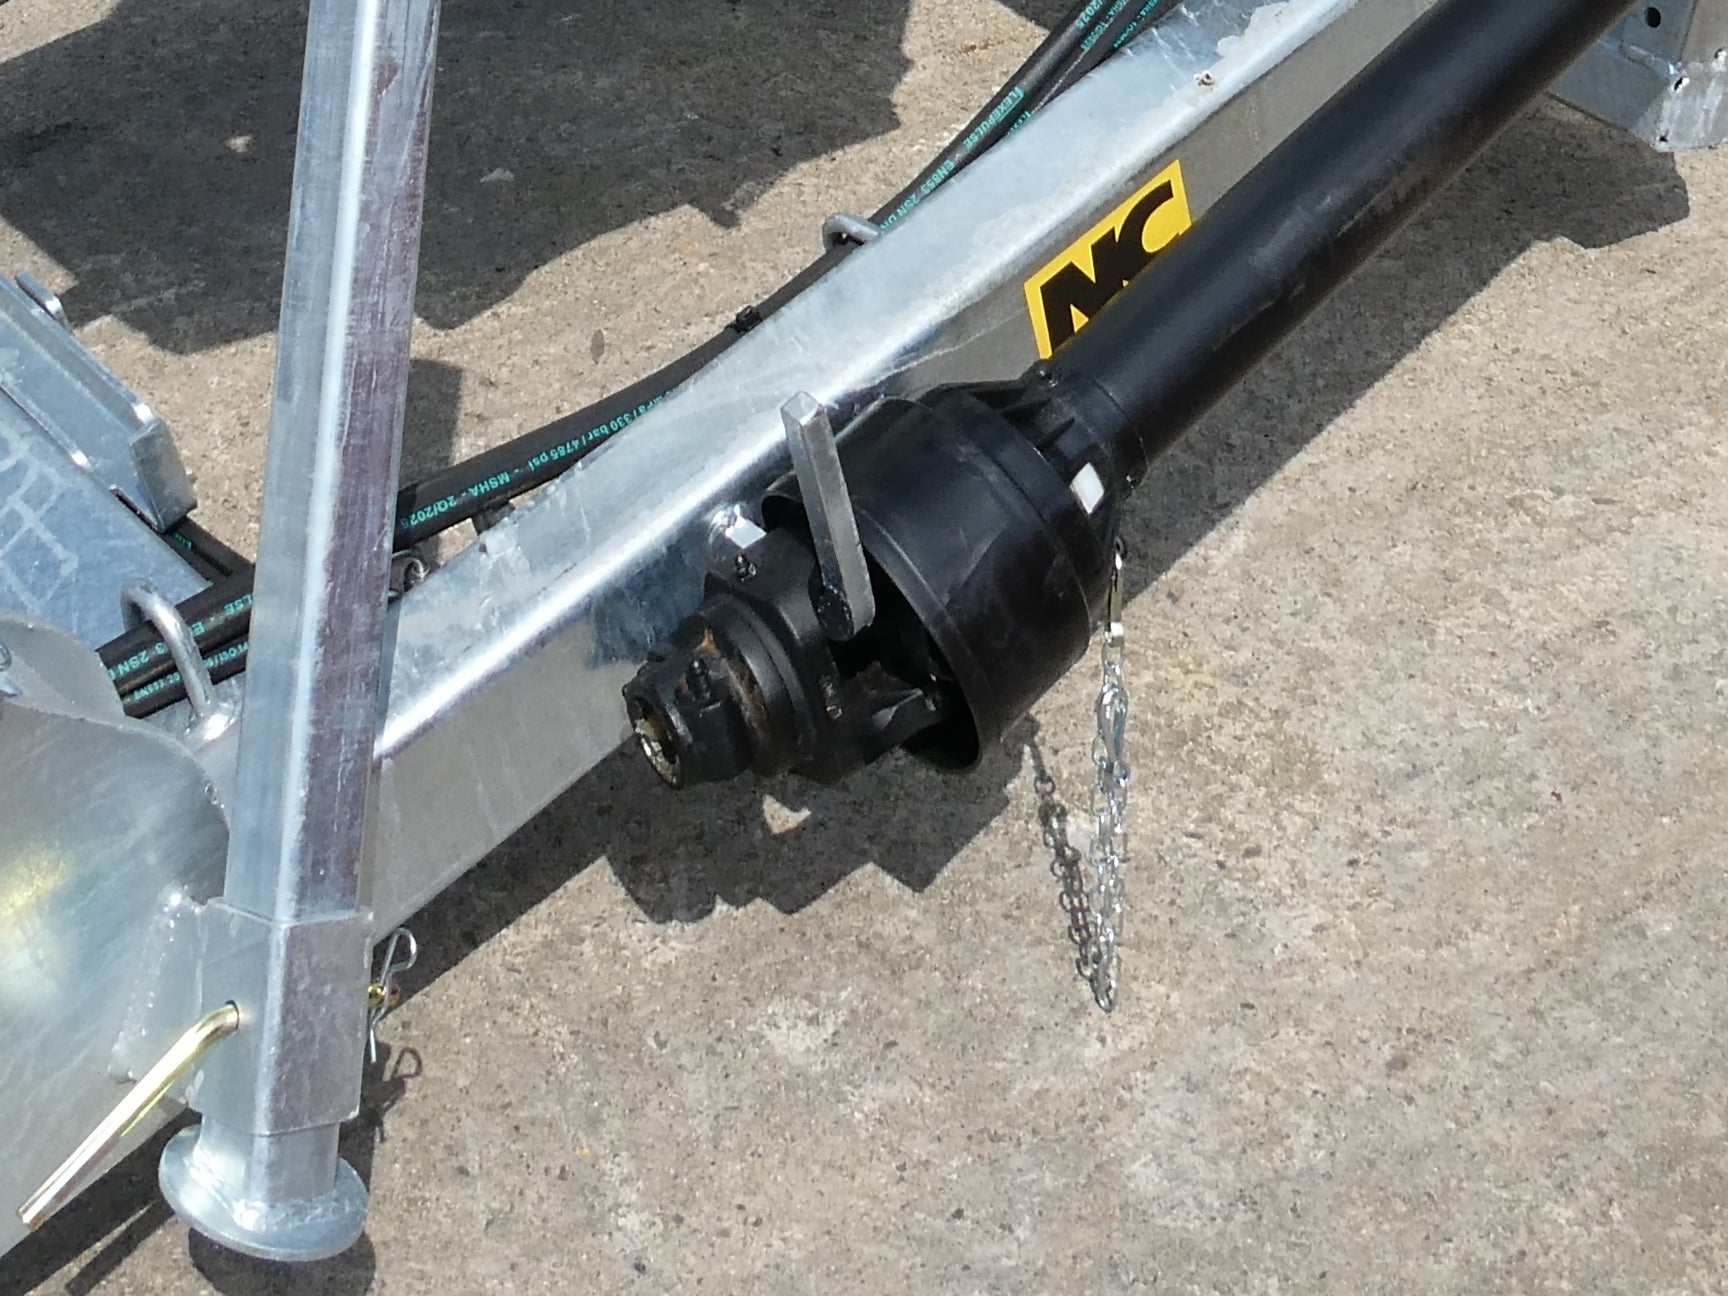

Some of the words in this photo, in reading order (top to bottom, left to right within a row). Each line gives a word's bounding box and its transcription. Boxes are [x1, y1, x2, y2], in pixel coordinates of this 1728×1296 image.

[960, 81, 1026, 154] FLEXEPULSE
[1040, 179, 1174, 354] NC
[584, 422, 610, 443] bar
[607, 411, 633, 432] 330
[525, 450, 550, 471] psi
[547, 437, 582, 462] 4785
[466, 469, 510, 497] MSHA
[396, 494, 458, 529] 2Q/2025
